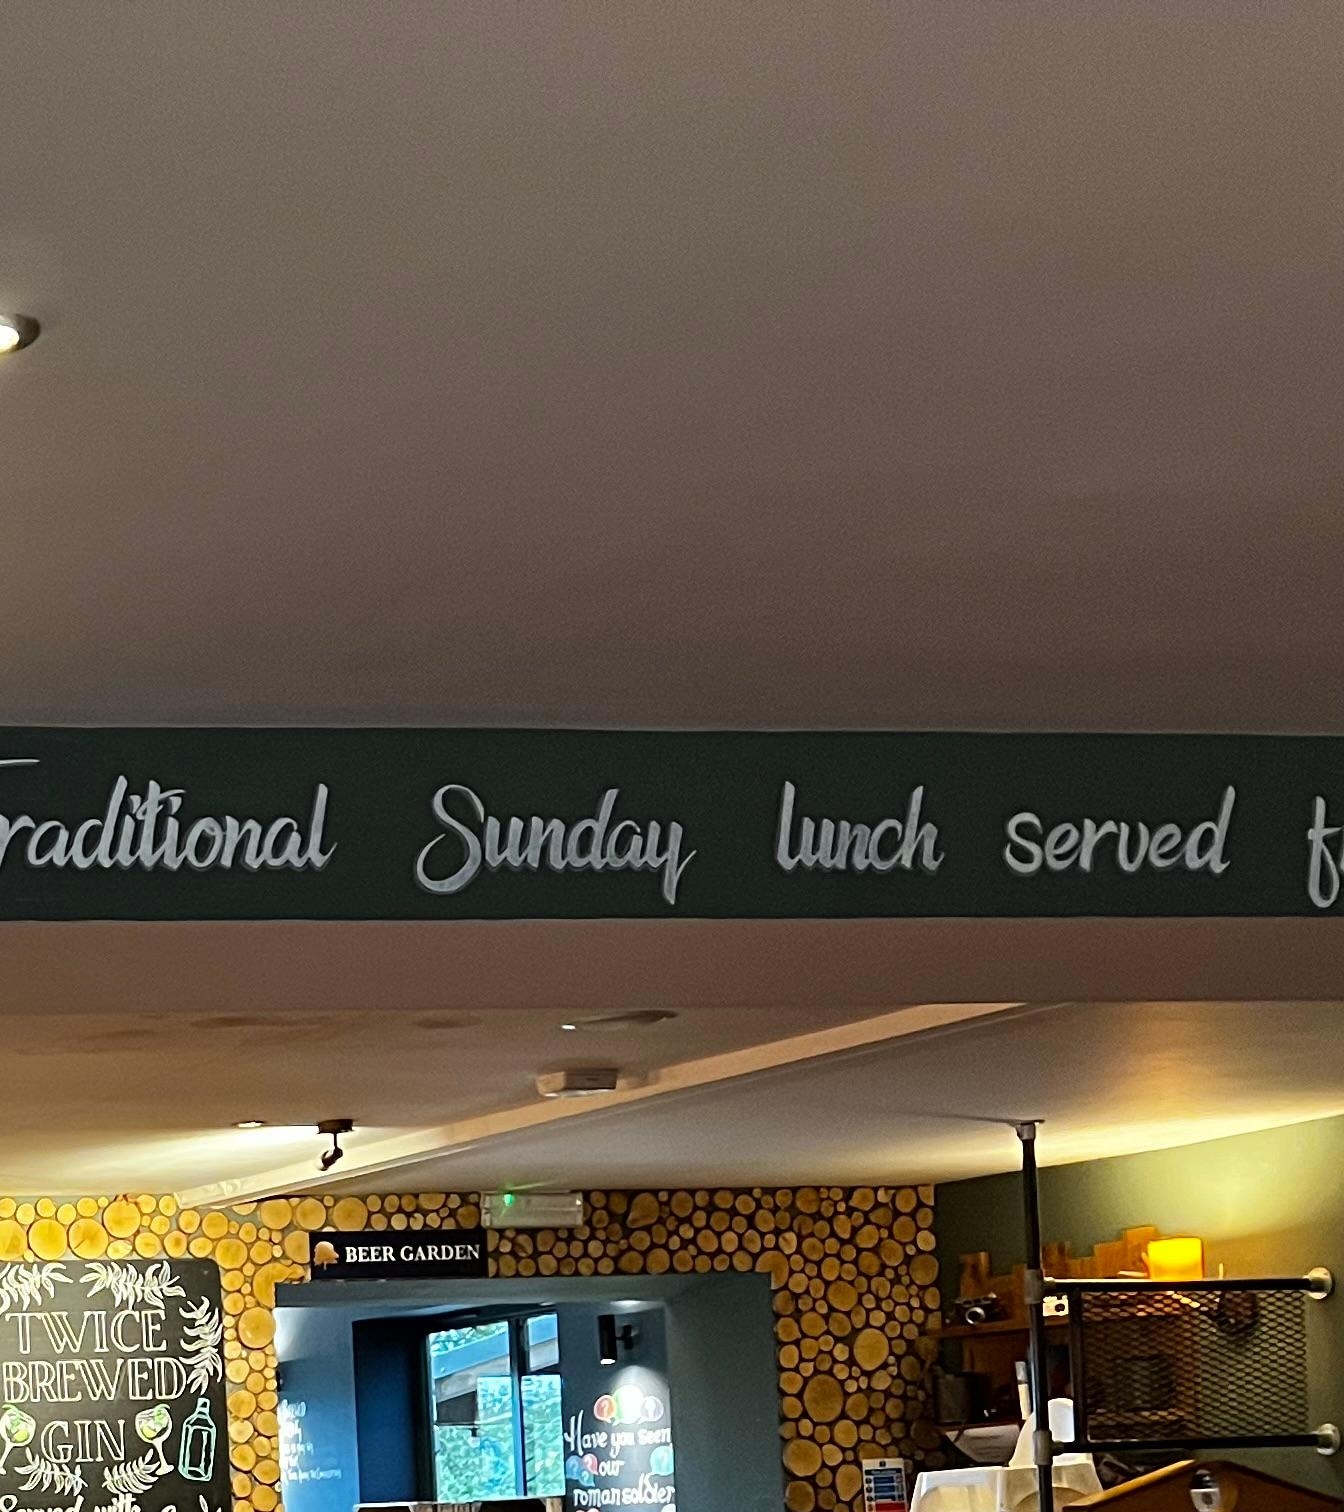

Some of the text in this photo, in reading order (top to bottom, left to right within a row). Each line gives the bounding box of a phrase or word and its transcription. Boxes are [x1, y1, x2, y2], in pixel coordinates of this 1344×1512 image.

[416, 784, 697, 905] Sunday
[775, 780, 945, 873] lunch
[1004, 785, 1236, 875] served
[1307, 795, 1344, 908] f
[344, 1243, 481, 1263] BEER GARDEN
[4, 1308, 168, 1355] TWICE
[1, 1356, 187, 1404] BREWED
[39, 1418, 127, 1464] GIN
[563, 1409, 672, 1459] Have you seen
[598, 1459, 626, 1477] our
[572, 1487, 621, 1508] roman
